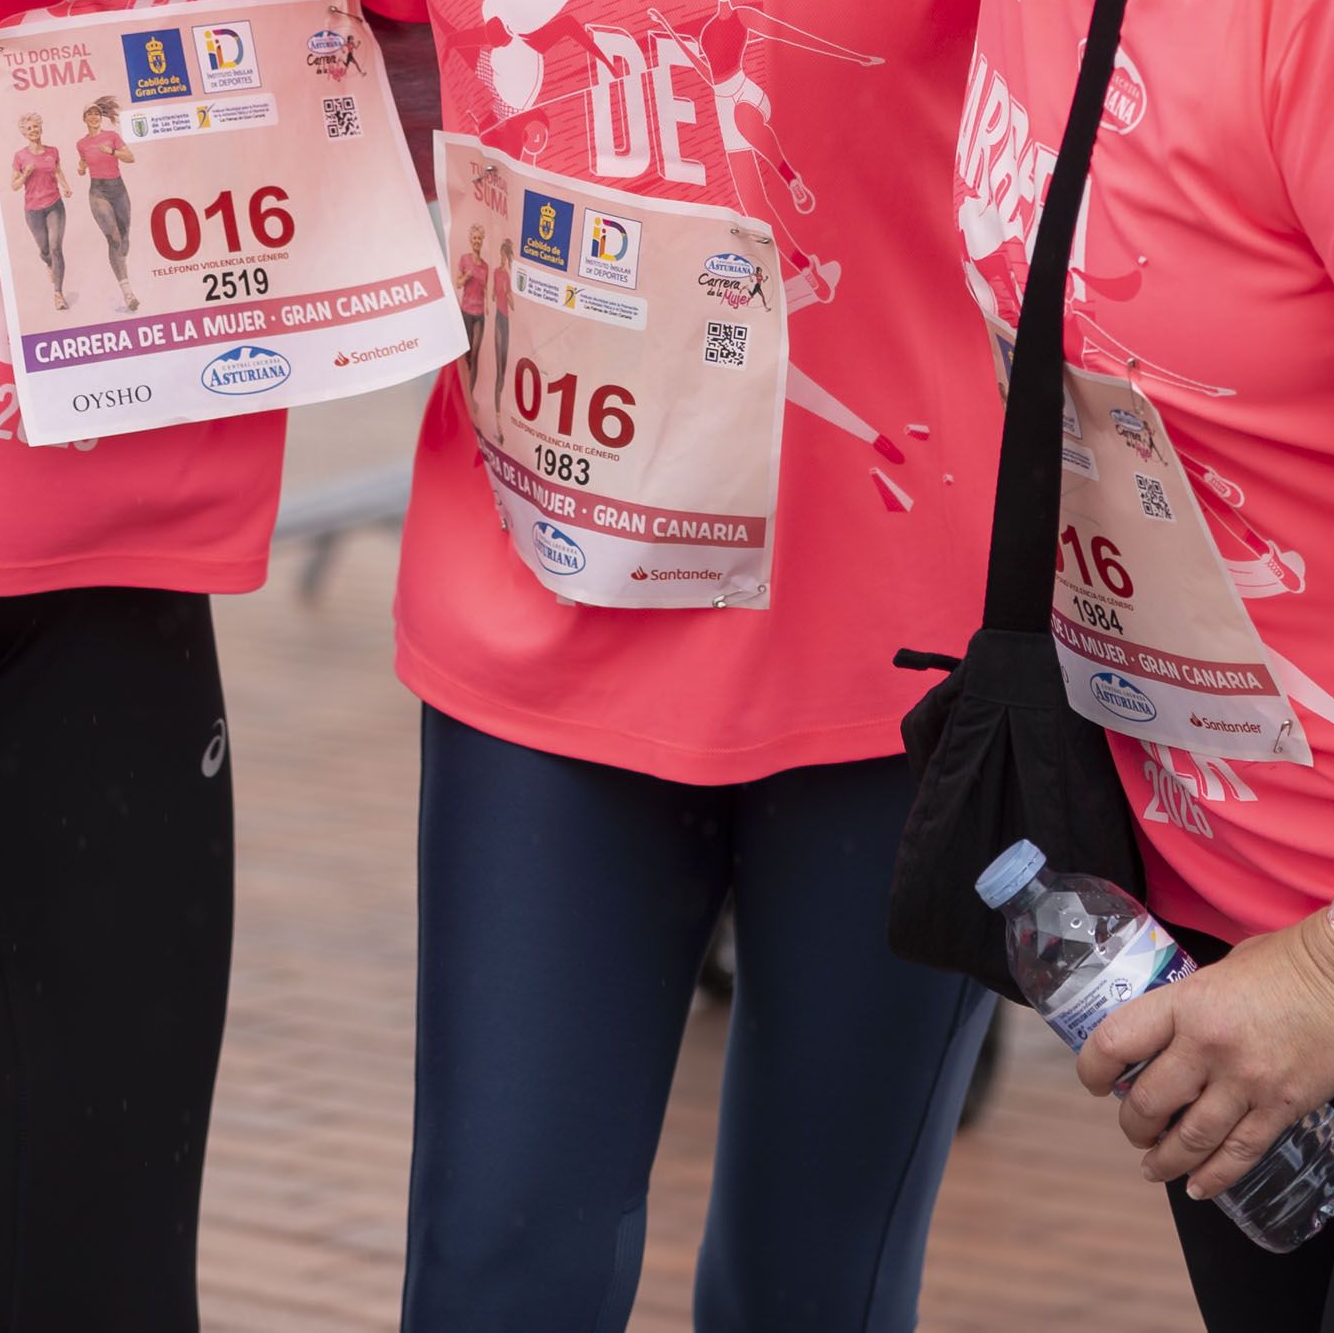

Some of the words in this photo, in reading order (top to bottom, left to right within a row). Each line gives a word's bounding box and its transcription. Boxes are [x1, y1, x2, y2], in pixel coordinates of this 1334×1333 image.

[3, 51, 24, 67] TU
[28, 43, 91, 64] DORSAL
[11, 59, 96, 91] SUMA
[219, 76, 253, 88] DEPORTES
[135, 85, 157, 98] Gran
[157, 83, 187, 94] Canaria
[584, 23, 707, 187] DE
[150, 185, 295, 261] 016
[152, 264, 199, 277] TELÉFONO
[201, 257, 245, 270] VIOLENCIA
[258, 252, 289, 262] GÉNERO
[523, 246, 539, 257] Gran
[539, 250, 565, 266] Canaria
[708, 260, 751, 275] ASTURIANA
[202, 267, 269, 301] 2519
[593, 268, 628, 283] DEPORTES
[698, 273, 741, 290] Carrera
[720, 289, 752, 309] Mujer
[35, 330, 133, 363] CARRERA
[138, 324, 166, 347] DE
[171, 320, 198, 342] LA
[203, 310, 267, 337] MUJER
[281, 300, 333, 326] GRAN
[336, 280, 428, 318] CANARIA
[351, 338, 420, 364] Santander
[210, 365, 286, 387] ASTURIANA
[72, 384, 153, 412] OYSHO
[515, 357, 636, 449] 016
[535, 431, 571, 450] VIOLENCIA
[573, 444, 584, 453] DE
[586, 447, 620, 462] GÉNERO
[535, 444, 590, 485] 1983
[503, 462, 516, 486] DE
[518, 471, 531, 496] LA
[532, 481, 575, 518] MUJER
[593, 504, 645, 534] GRAN
[652, 518, 748, 542] CANARIA
[651, 568, 723, 581] Santander
[1056, 524, 1134, 598] 16
[1073, 595, 1124, 635] 1984
[1064, 624, 1081, 649] LA
[1080, 633, 1129, 666] MUJER
[1138, 652, 1181, 681] GRAN
[1182, 665, 1263, 690] CANARIA
[1095, 682, 1153, 716] ASTURIANA
[1203, 717, 1262, 734] Santander
